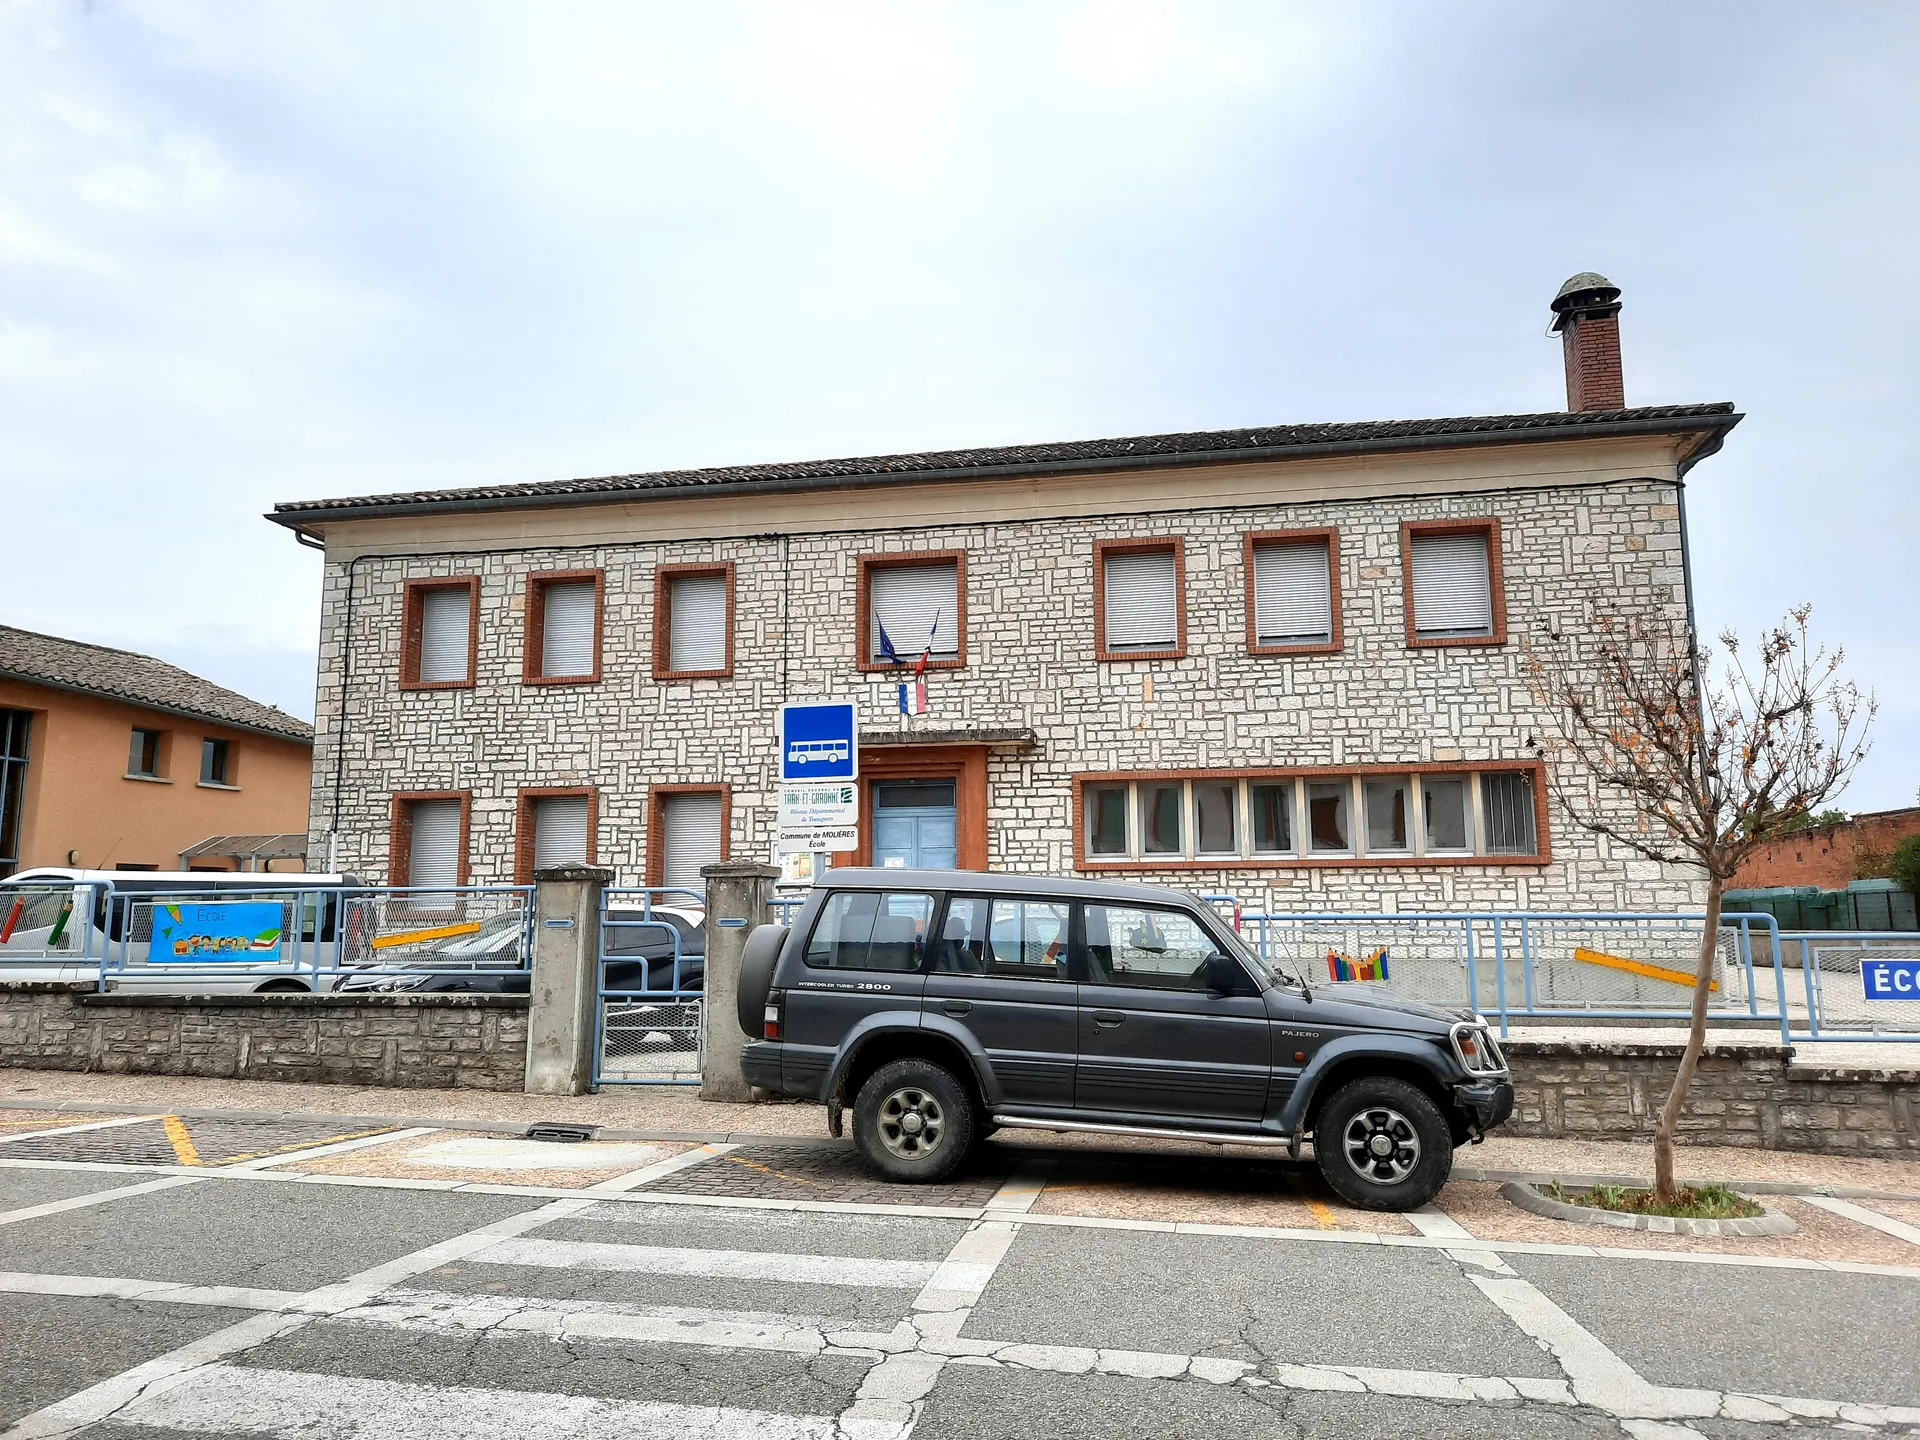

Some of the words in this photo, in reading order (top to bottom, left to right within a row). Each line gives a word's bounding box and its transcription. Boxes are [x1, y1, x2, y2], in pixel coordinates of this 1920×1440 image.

[784, 792, 839, 805] TARN-ET-GARONNE
[780, 832, 811, 840] Commune
[809, 839, 826, 848] École
[197, 905, 227, 922] ÉCOLE
[856, 982, 892, 991] 2800
[1281, 1029, 1320, 1038] PAJERO
